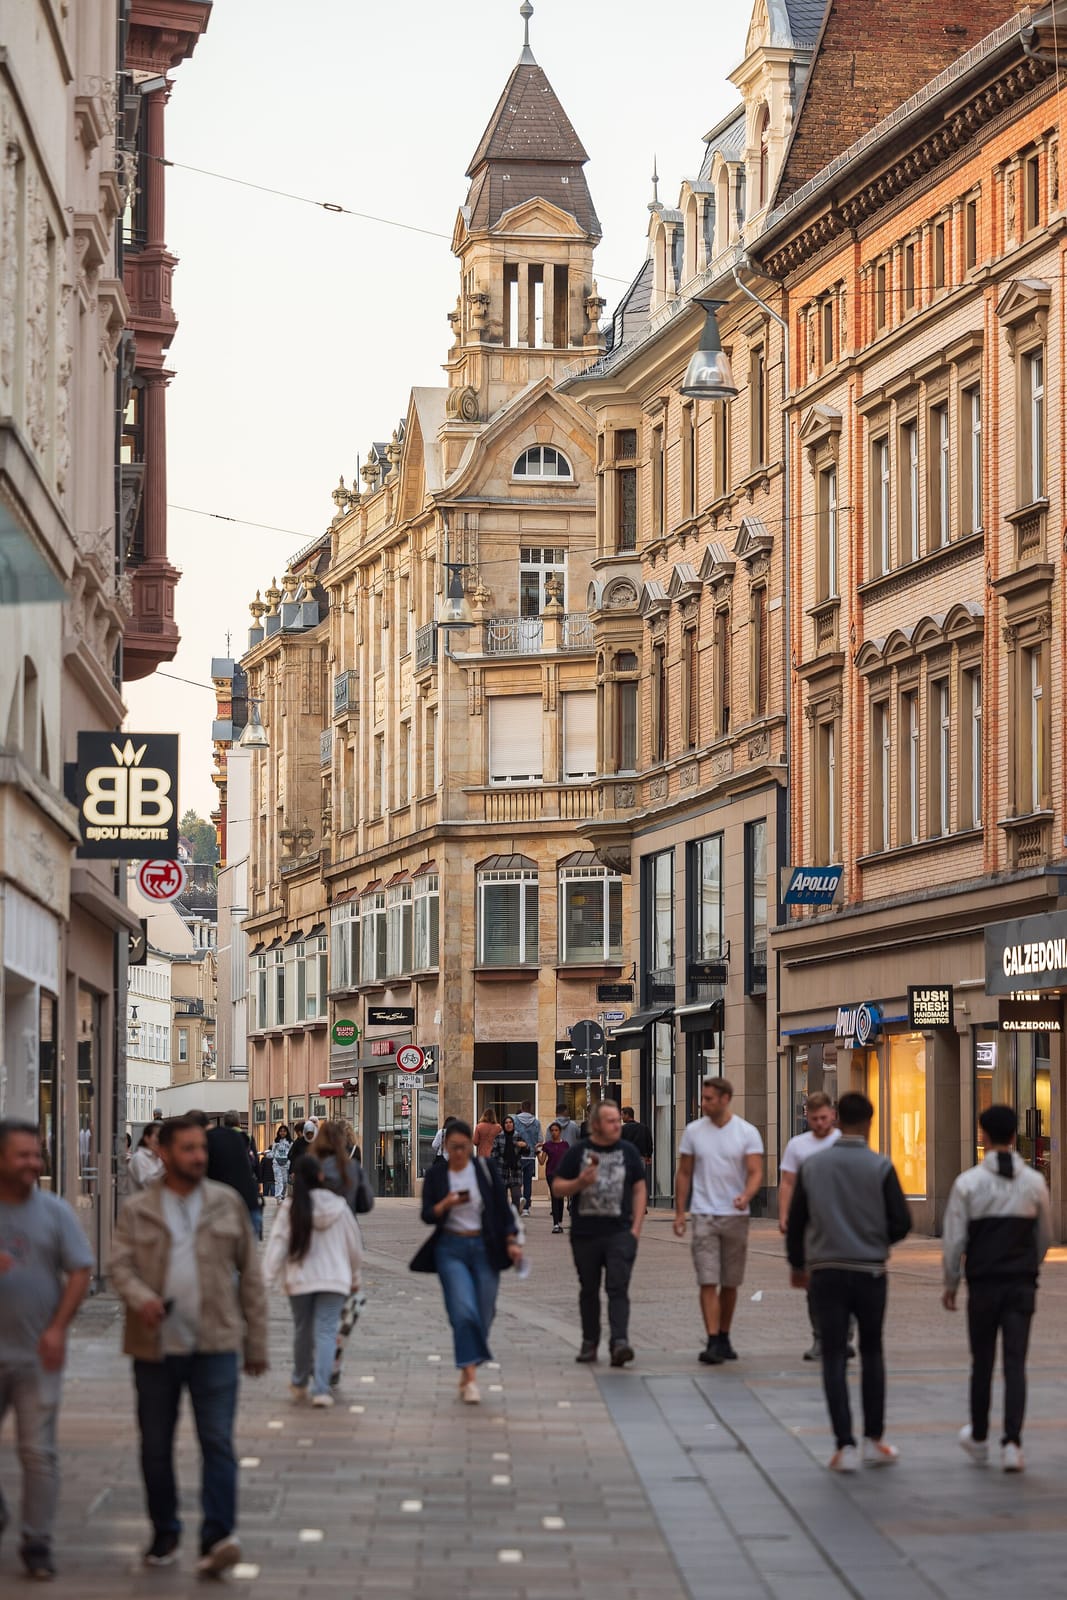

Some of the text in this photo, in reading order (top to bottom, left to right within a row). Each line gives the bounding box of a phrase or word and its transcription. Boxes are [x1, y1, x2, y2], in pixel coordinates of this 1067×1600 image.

[86, 827, 168, 841] BIJOU BRIGITTE
[790, 873, 838, 891] APOLLO
[1003, 938, 1067, 976] CALZEDONI
[913, 991, 949, 1002] LUSH
[914, 1002, 949, 1011] FRESH
[1003, 1021, 1060, 1030] CALZEDONIA
